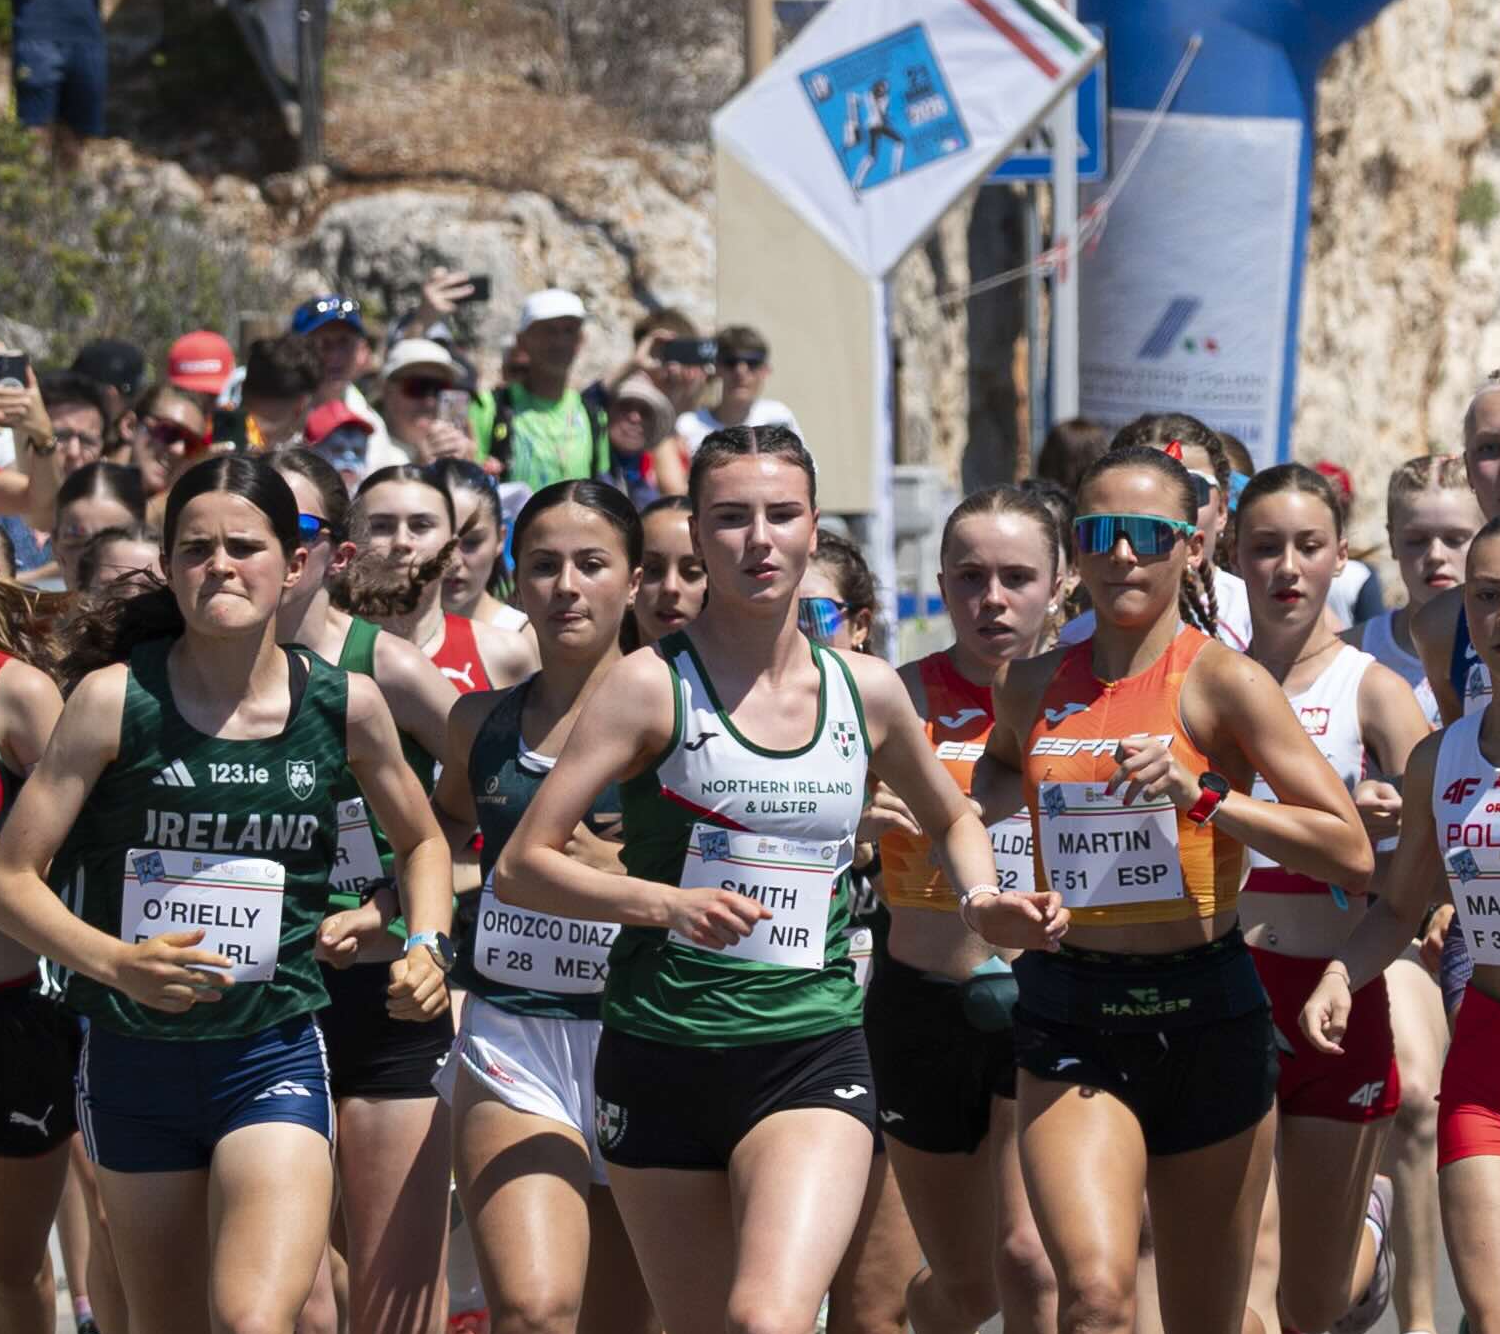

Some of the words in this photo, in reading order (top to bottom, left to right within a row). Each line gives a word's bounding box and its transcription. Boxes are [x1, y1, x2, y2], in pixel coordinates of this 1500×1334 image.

[208, 763, 269, 783] 123.ie
[701, 780, 787, 795] NORTHERN
[793, 781, 853, 796] IRELAND
[744, 802, 756, 813] &
[761, 801, 817, 814] ULSTER
[144, 810, 318, 851] IRELAND
[1058, 830, 1150, 855] MARTIN
[1065, 870, 1088, 889] 51
[1118, 864, 1168, 887] ESP
[720, 880, 798, 909] SMITH
[143, 898, 260, 929] O'RIELLY
[483, 911, 564, 941] OROZCO
[569, 923, 613, 948] DIAZ
[769, 925, 810, 948] NIR
[1473, 930, 1484, 948] F
[219, 943, 259, 965] IRL
[486, 948, 500, 966] F
[506, 950, 534, 972] 28
[554, 957, 607, 981] MEX
[1102, 998, 1192, 1016] HANKER
